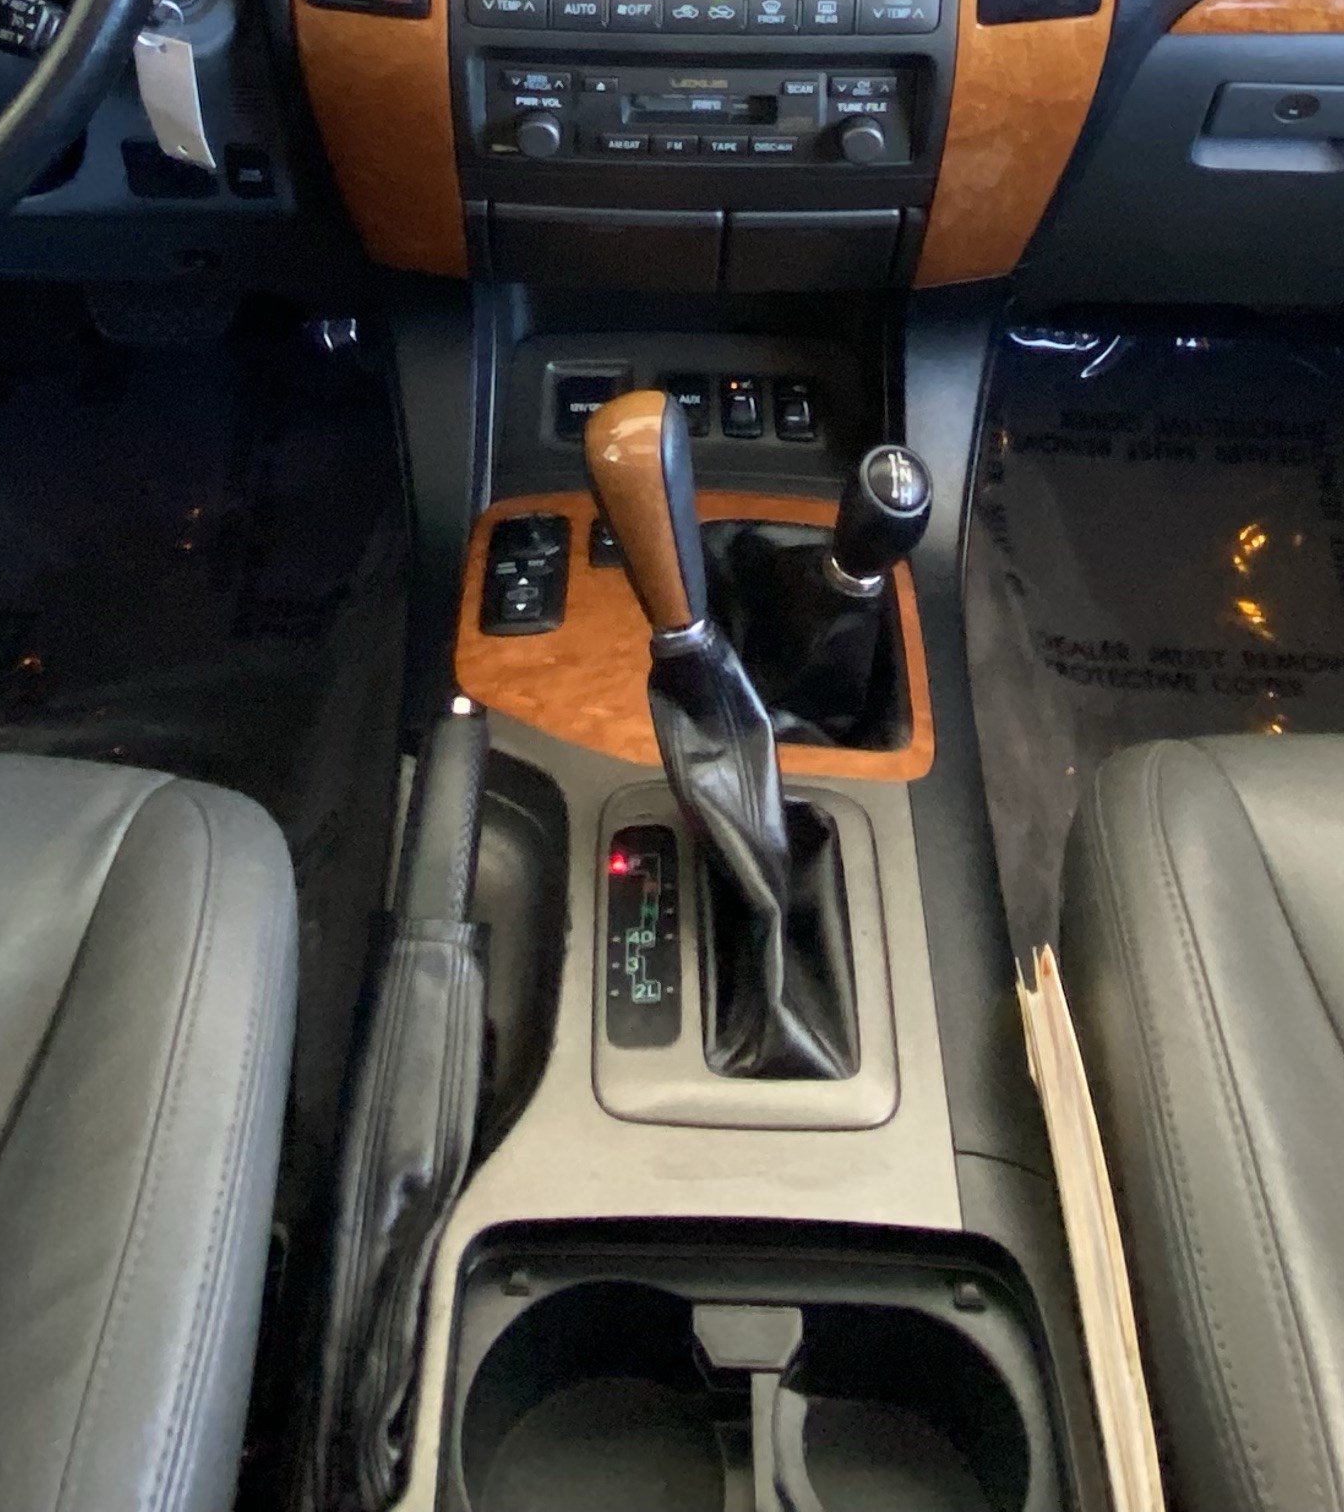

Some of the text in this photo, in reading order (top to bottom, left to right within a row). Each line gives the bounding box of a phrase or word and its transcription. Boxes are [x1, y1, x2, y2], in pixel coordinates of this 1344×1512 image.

[497, 0, 522, 11] TEMP
[564, 3, 597, 15] AUTO
[627, 4, 652, 15] OFF
[887, 8, 911, 19] TEMP
[757, 15, 786, 24] FRONT
[814, 15, 838, 24] REAR
[786, 84, 814, 94] SCAN
[666, 141, 683, 150] FM
[712, 142, 737, 152] TAPE
[679, 394, 701, 405] AUX
[896, 451, 910, 466] L
[899, 467, 913, 483] N
[900, 485, 913, 505] H
